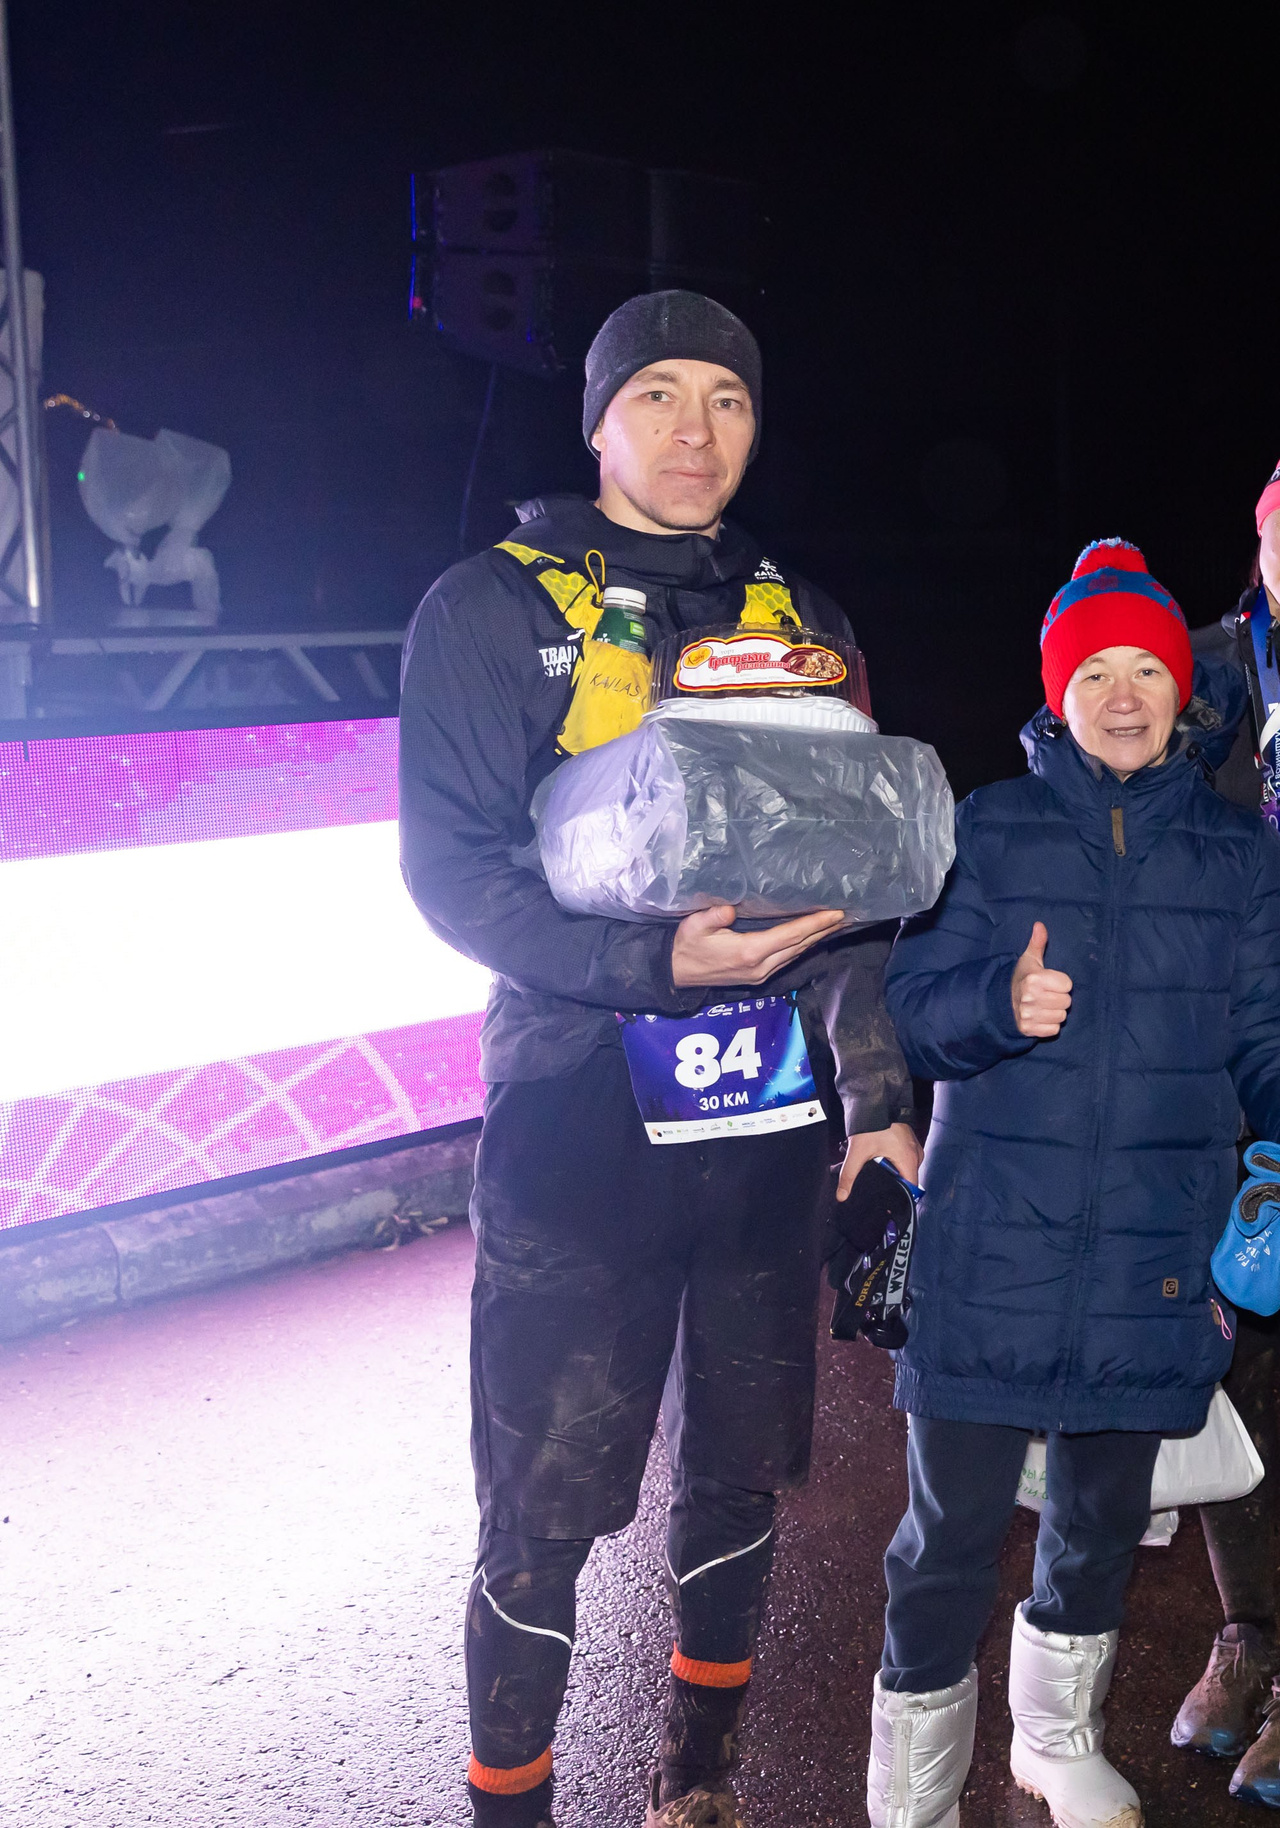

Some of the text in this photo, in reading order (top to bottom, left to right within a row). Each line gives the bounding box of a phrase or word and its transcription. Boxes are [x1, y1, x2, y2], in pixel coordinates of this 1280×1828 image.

[589, 672, 642, 697] KAILAS
[674, 1026, 762, 1090] 84
[699, 1096, 719, 1111] 30
